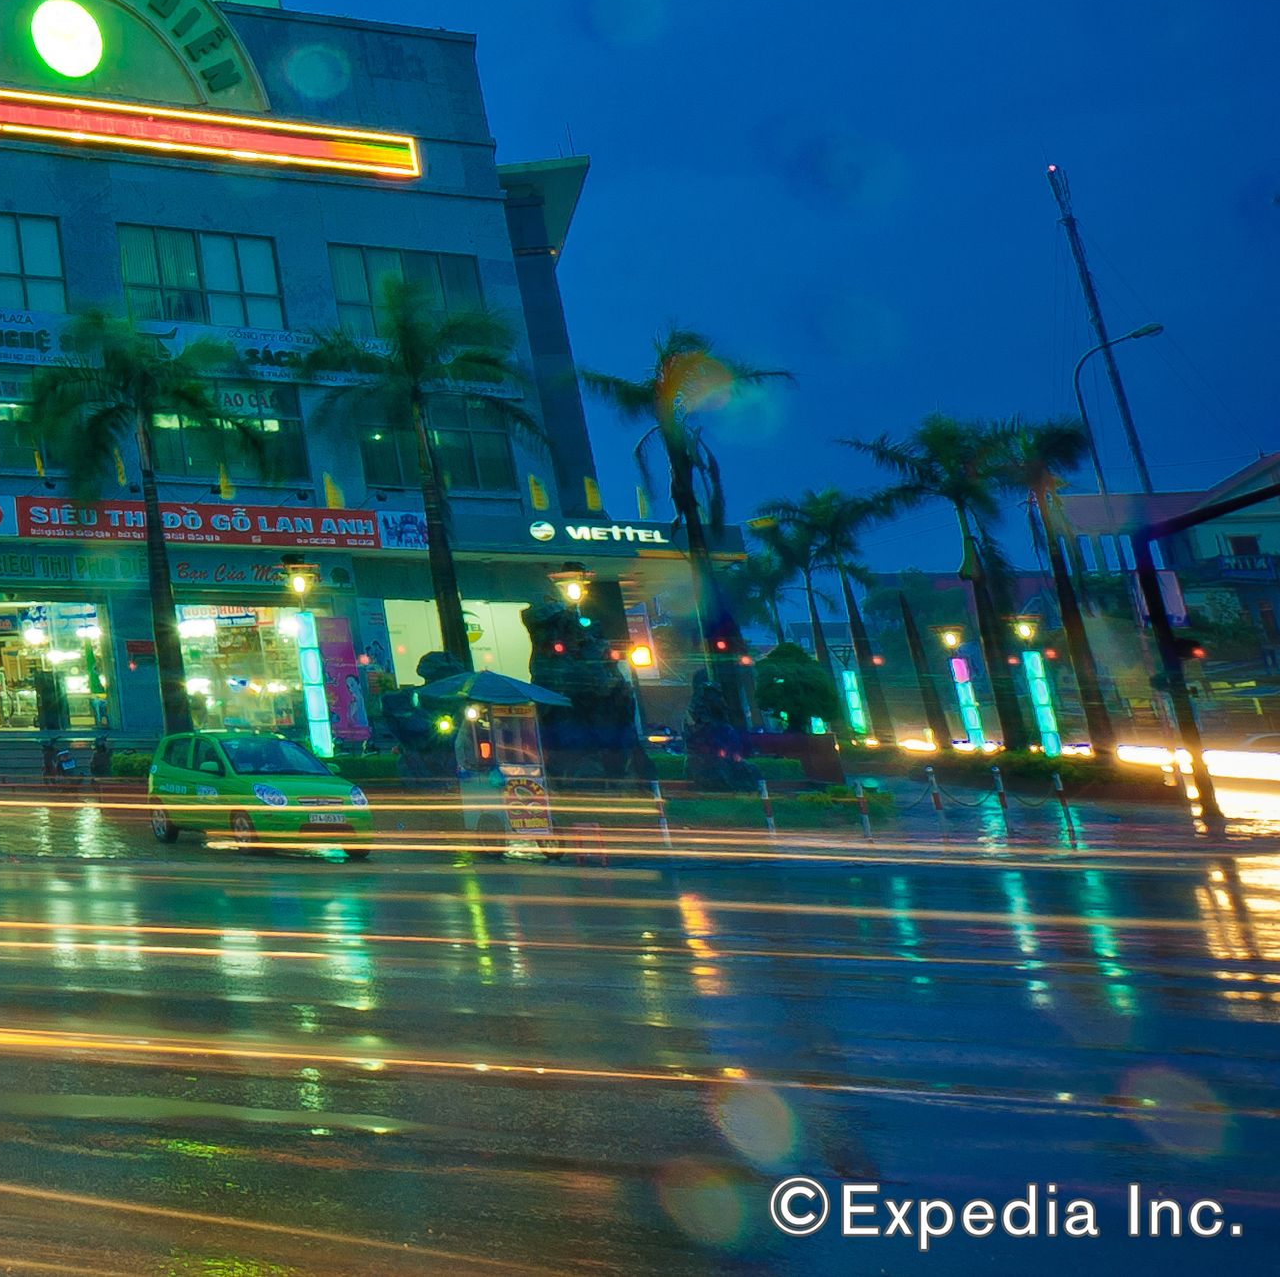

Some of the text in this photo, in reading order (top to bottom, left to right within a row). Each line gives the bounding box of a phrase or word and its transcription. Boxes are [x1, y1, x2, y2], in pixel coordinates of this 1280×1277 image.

[29, 504, 97, 526] SIÊU
[104, 509, 147, 527] TH
[257, 515, 314, 534] LAN
[319, 518, 376, 536] ANH
[565, 525, 670, 543] VIETTEL
